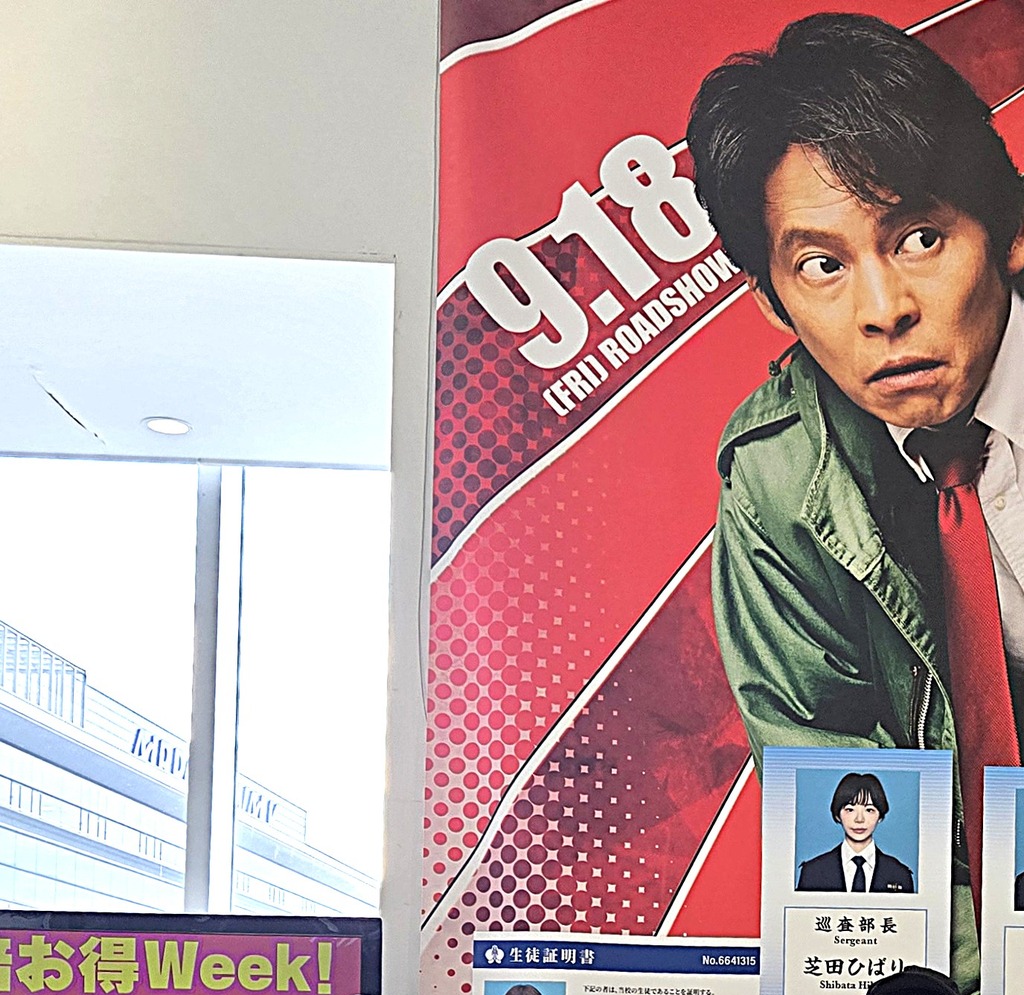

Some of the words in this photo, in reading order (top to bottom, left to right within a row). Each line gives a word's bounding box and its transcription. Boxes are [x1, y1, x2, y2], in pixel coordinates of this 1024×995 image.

[464, 135, 718, 369] 9.18
[600, 248, 742, 370] ROADSHOW
[815, 916, 898, 934] 巡査部長
[834, 936, 878, 947] Sergeant
[0, 934, 333, 995] お得Week!
[509, 947, 596, 965] 生徒証明書
[702, 955, 757, 966] No.6641315
[803, 956, 904, 977] 芝田ひばり
[819, 980, 856, 989] Shibata
